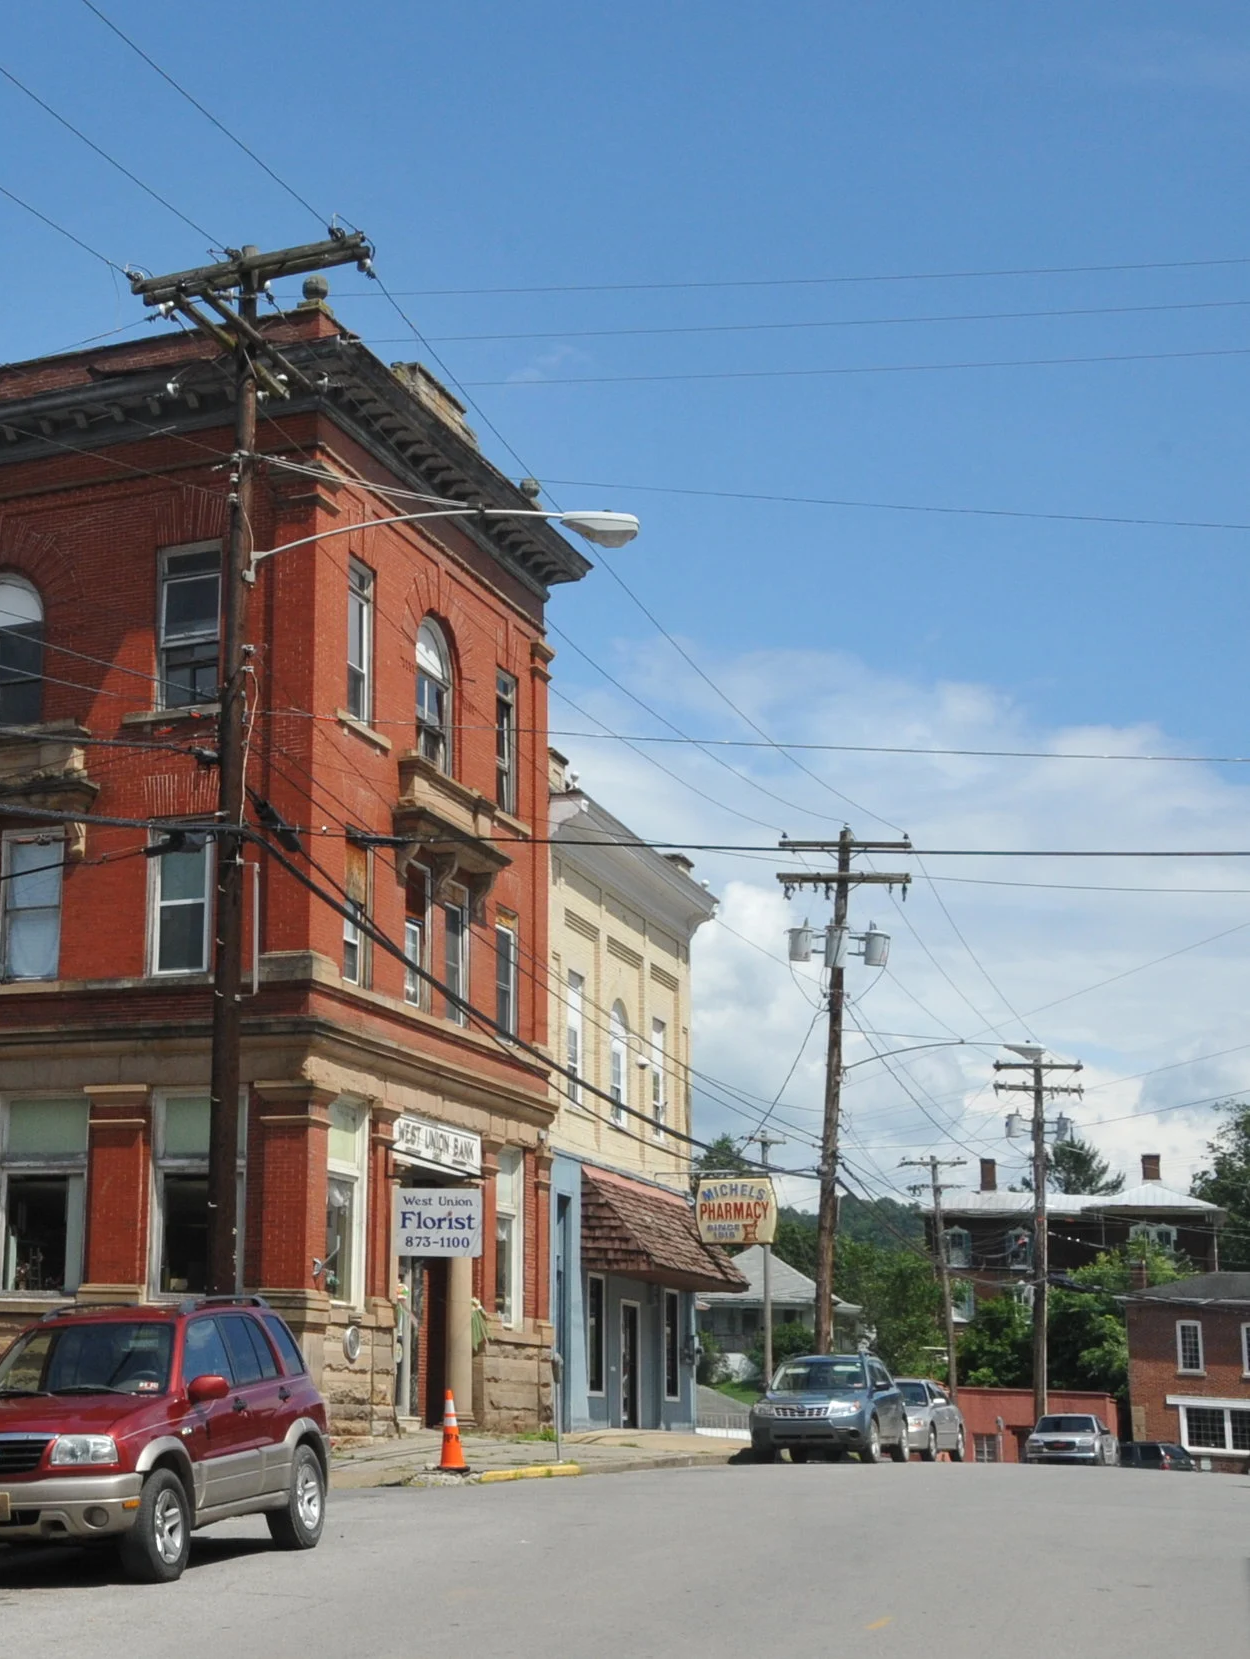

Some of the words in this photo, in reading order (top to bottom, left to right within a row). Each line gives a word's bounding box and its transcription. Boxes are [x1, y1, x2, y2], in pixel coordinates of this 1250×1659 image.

[398, 1120, 422, 1147] WEST
[425, 1129, 450, 1155] UNION
[453, 1137, 475, 1161] BANK
[702, 1183, 766, 1200] MICHELS
[403, 1196, 433, 1206] West
[438, 1196, 473, 1206] Union
[699, 1201, 769, 1221] PHARMACY
[400, 1211, 476, 1230] Florist
[405, 1236, 470, 1248] 873-1100
